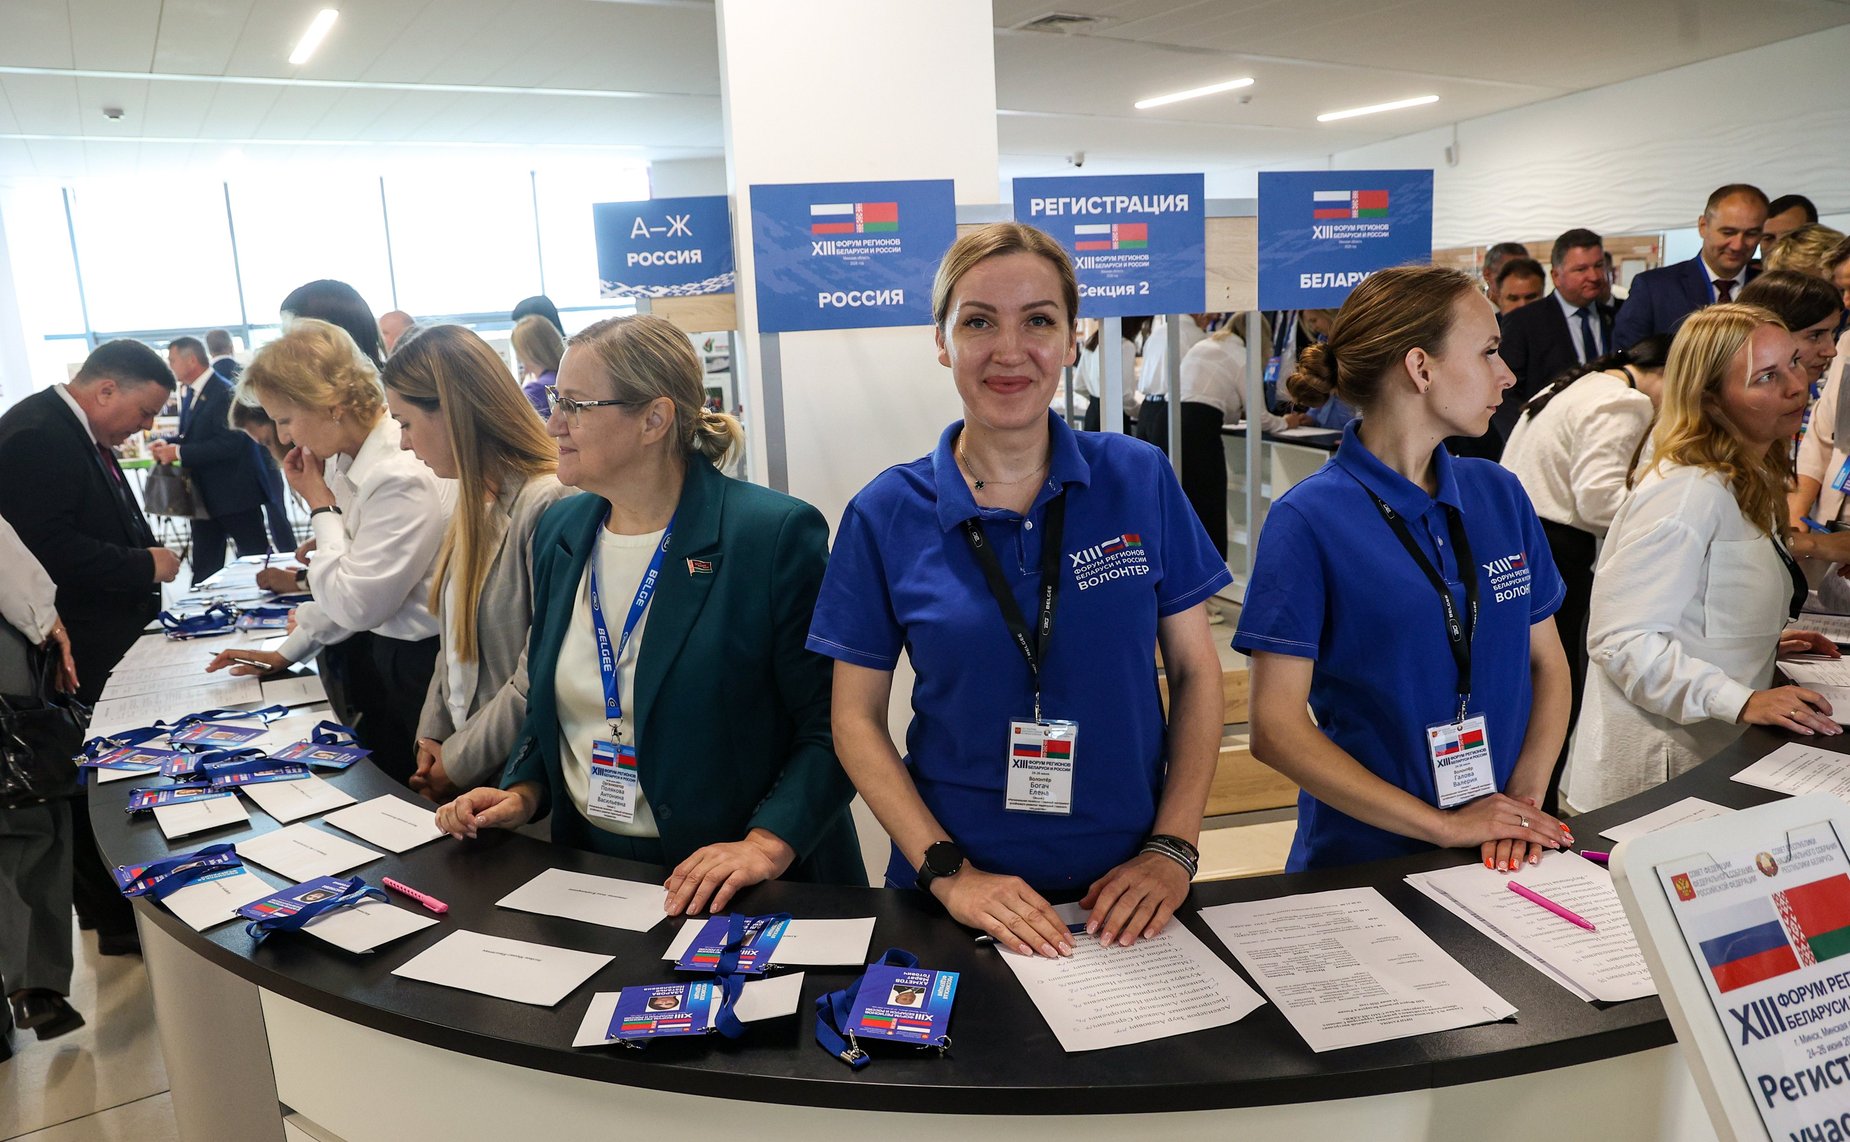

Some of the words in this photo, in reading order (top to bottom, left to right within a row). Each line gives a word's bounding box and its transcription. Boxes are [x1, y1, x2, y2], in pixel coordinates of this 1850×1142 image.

[1030, 194, 1190, 217] РЕГИСТРАЦИЯ
[1312, 225, 1333, 239] XIII
[1357, 223, 1389, 231] РЕГИОНОВ
[811, 241, 835, 256] XIII
[862, 238, 901, 246] РЕГИОНОВ
[626, 249, 702, 268] РОССИЯ
[1074, 256, 1095, 270] XIII
[1077, 284, 1135, 298] Секция
[1139, 281, 1150, 295] 2
[1300, 272, 1377, 288] БЕЛАРУ
[818, 289, 903, 308] РОССИЯ
[1068, 545, 1103, 568] XIII
[1073, 560, 1105, 575] ФОРУМ
[1105, 549, 1145, 563] РЕГИОНОВ
[1075, 563, 1115, 581] БЕЛАРУСИ
[1122, 556, 1147, 564] РОССИИ
[1482, 557, 1513, 577] XIII
[1078, 565, 1150, 590] ВОЛОНТЕР
[1490, 572, 1515, 584] ФОРУМ
[636, 569, 658, 607] BELGE
[598, 628, 612, 672] BELGEE
[1012, 759, 1028, 769] XIII
[895, 978, 929, 986] АХМЕТОВ
[1728, 996, 1787, 1046] XIII
[1777, 979, 1828, 1008] ФОРУМ
[1785, 997, 1850, 1030] БЕЛАРУСИ
[1821, 1023, 1848, 1037] Минская
[1826, 1040, 1843, 1052] июня
[1757, 1055, 1849, 1109] Регист
